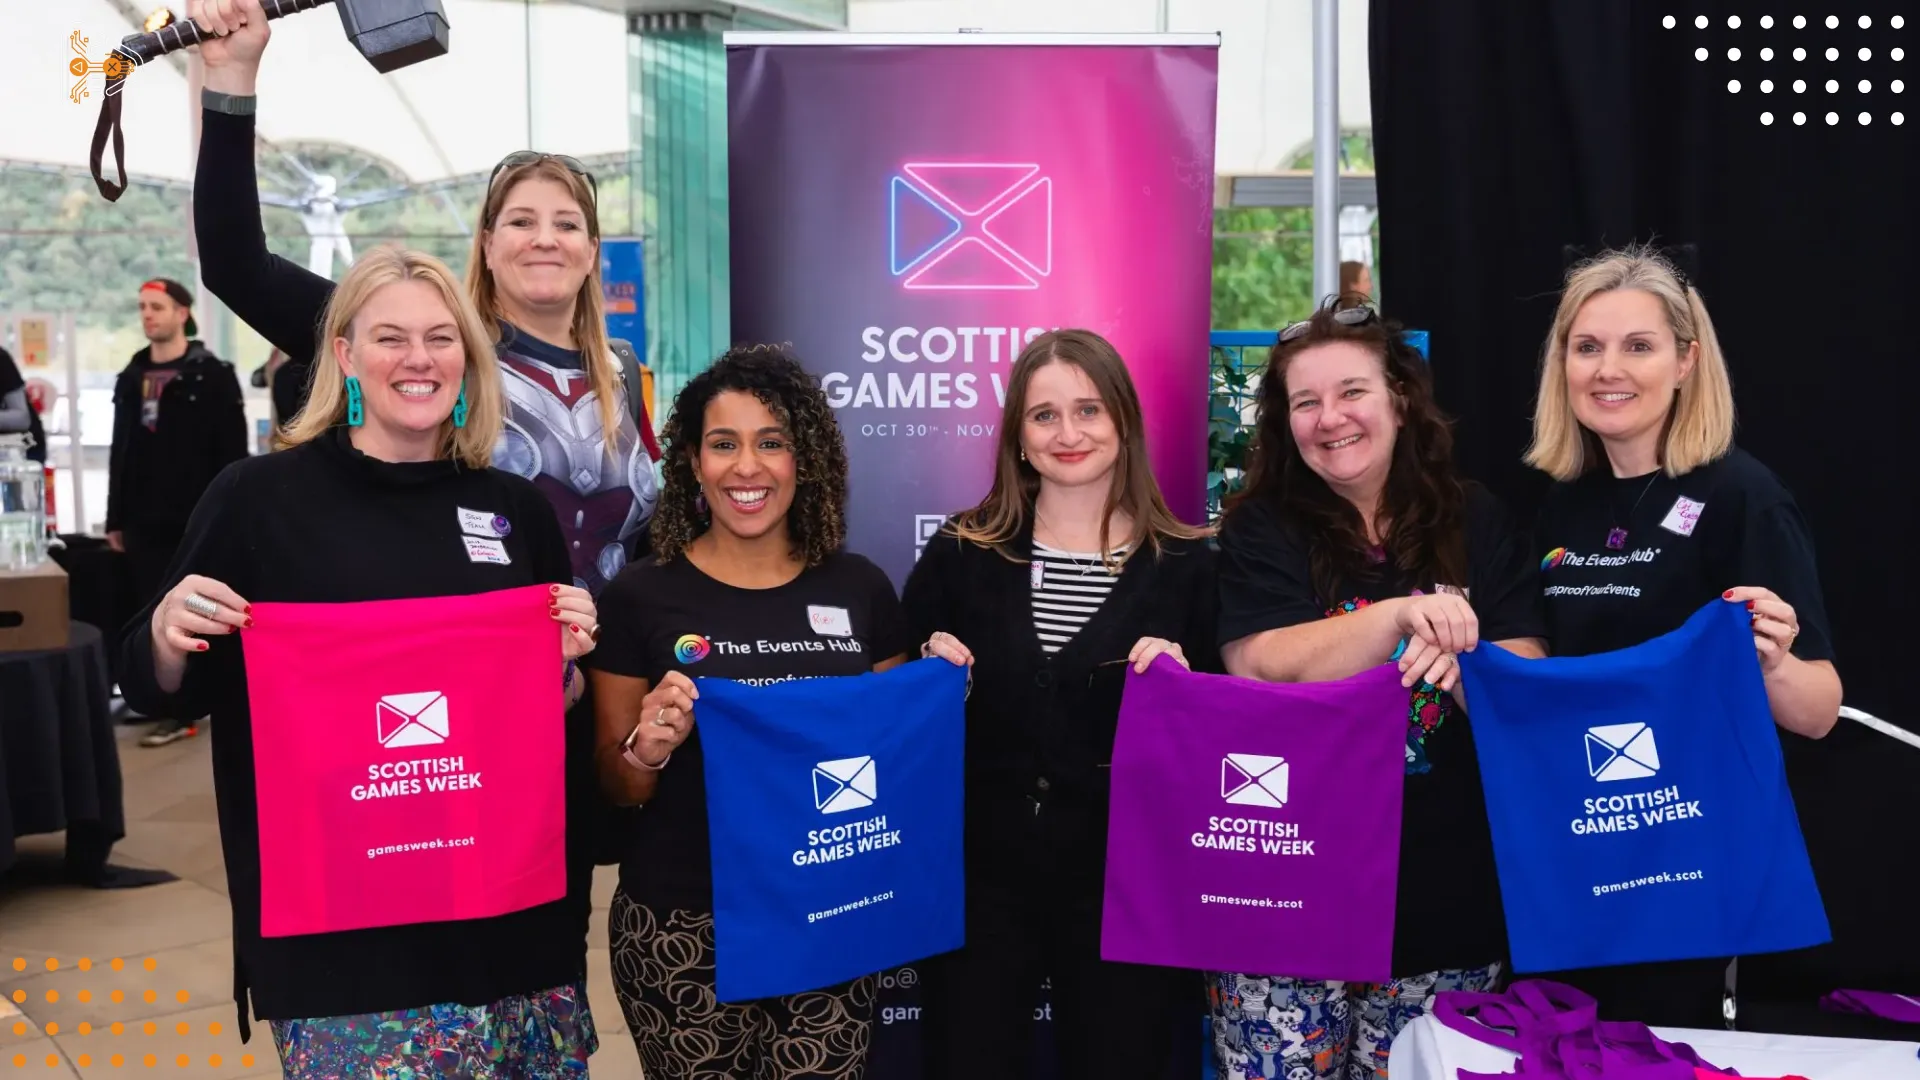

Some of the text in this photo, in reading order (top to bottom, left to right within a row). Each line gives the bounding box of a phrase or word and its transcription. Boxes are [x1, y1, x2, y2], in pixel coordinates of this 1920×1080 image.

[861, 326, 1060, 363] SCOTTI
[821, 371, 978, 409] GAMES
[861, 423, 898, 437] OCT
[957, 423, 996, 437] NOV
[1560, 550, 1585, 566] The
[1585, 553, 1629, 567] Events
[714, 638, 863, 655] The Events Hub
[368, 756, 465, 780] SCOTTISH
[351, 772, 483, 801] GAMES WEEK
[1584, 785, 1680, 815] SCOTTISH
[808, 815, 887, 846] SCOTTISH
[1208, 816, 1299, 838] SCOTTISH
[1571, 800, 1704, 835] GAMES WEEK
[367, 836, 476, 859] gamesweek.scot
[792, 829, 902, 866] GAMES WEEK
[1191, 832, 1315, 855] GAMES WEEK
[1592, 869, 1704, 896] gamesweek.scot
[807, 890, 894, 923] gamesweek.scot
[1201, 894, 1303, 909] gamesweek.scot
